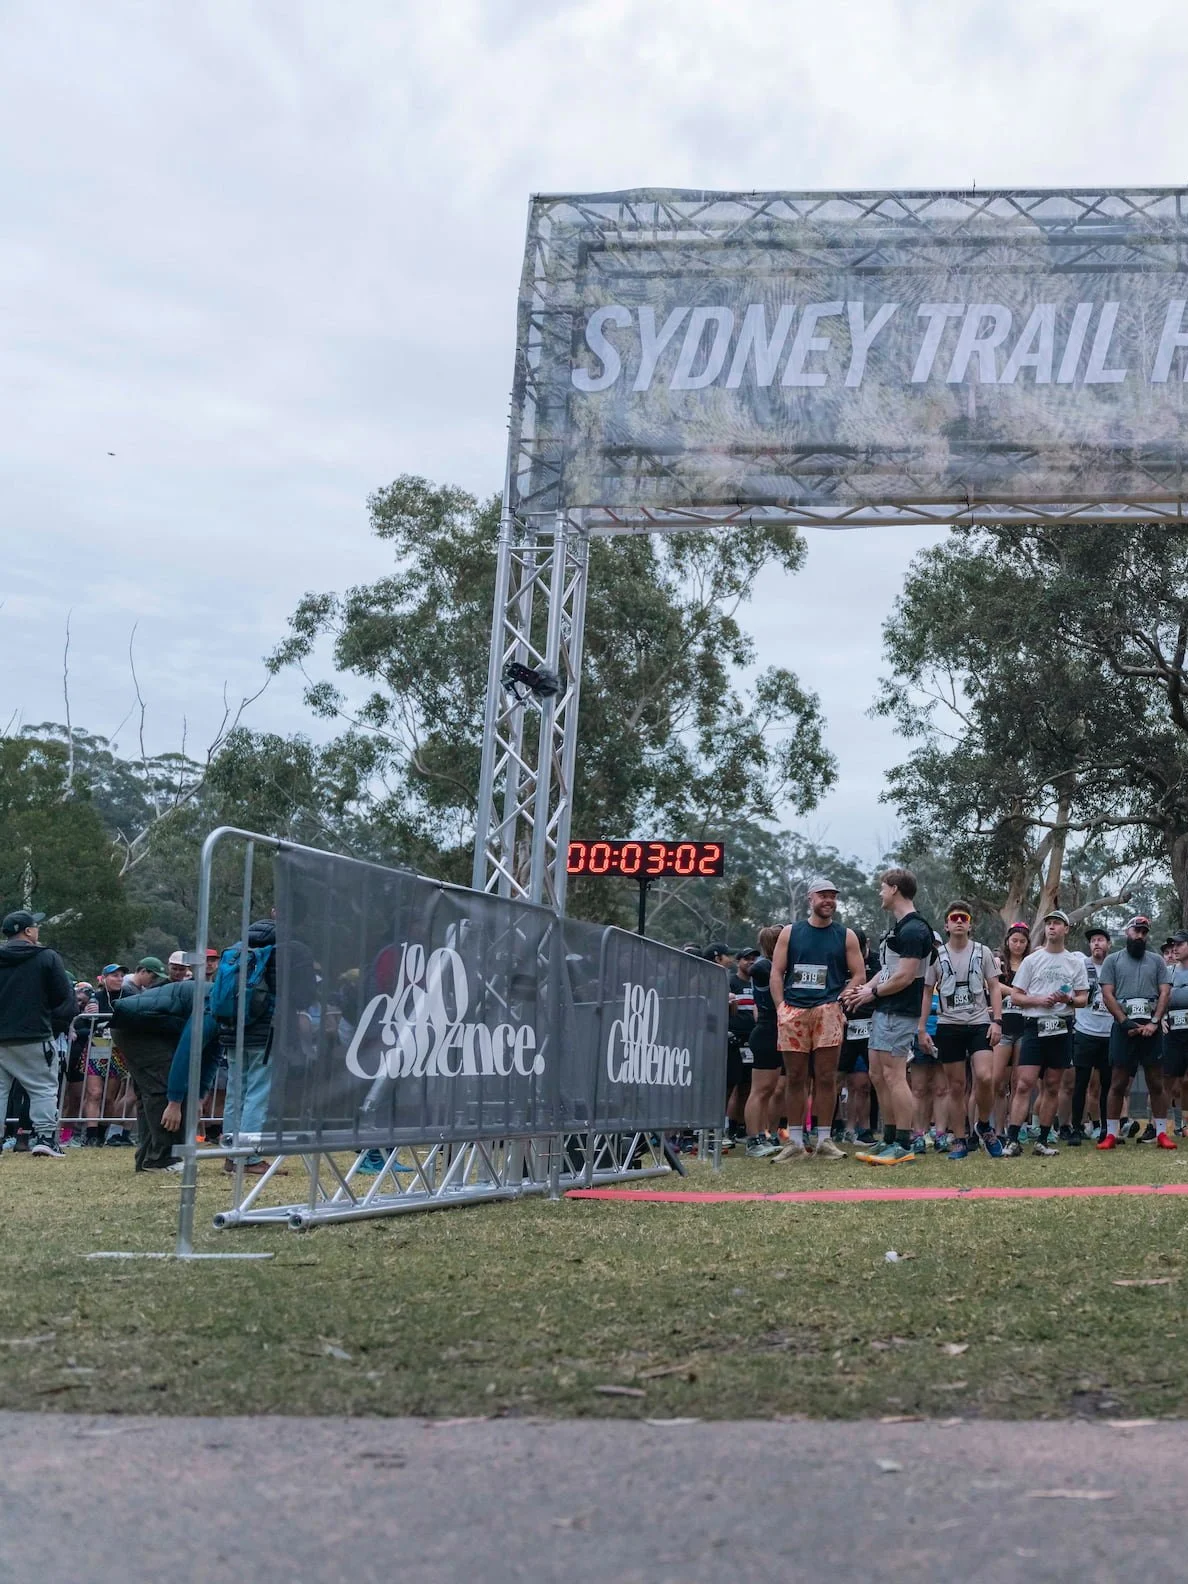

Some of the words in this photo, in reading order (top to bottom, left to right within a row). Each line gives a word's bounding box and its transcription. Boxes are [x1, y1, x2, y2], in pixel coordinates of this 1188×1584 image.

[571, 299, 900, 392] SYDNEY
[908, 300, 1128, 384] TRAIL
[567, 843, 721, 874] 00:03:02
[385, 942, 469, 1025] 180
[800, 972, 818, 983] 819
[953, 994, 969, 1005] 693
[1131, 1004, 1145, 1014] 628
[621, 982, 660, 1045] 180
[1044, 1020, 1060, 1031] 902
